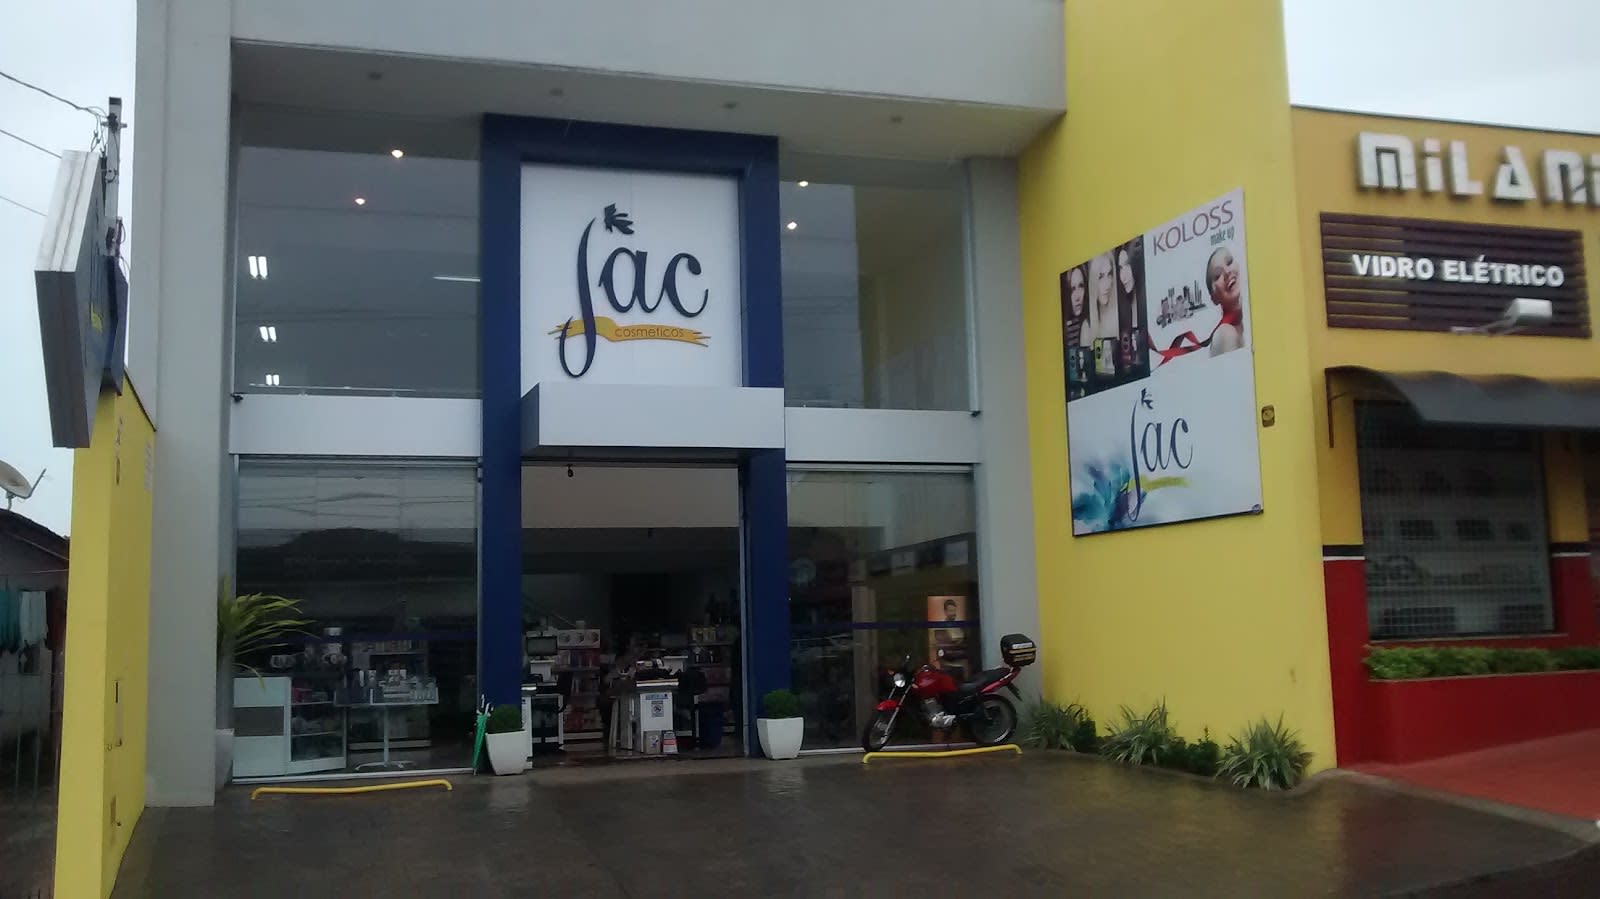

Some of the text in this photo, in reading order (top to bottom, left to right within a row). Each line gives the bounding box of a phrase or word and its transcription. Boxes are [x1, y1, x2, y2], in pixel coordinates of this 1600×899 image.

[1153, 200, 1233, 256] KOLOSS
[1352, 254, 1565, 287] VIDRO ELÉTRICO
[614, 327, 685, 338] cosmeticos
